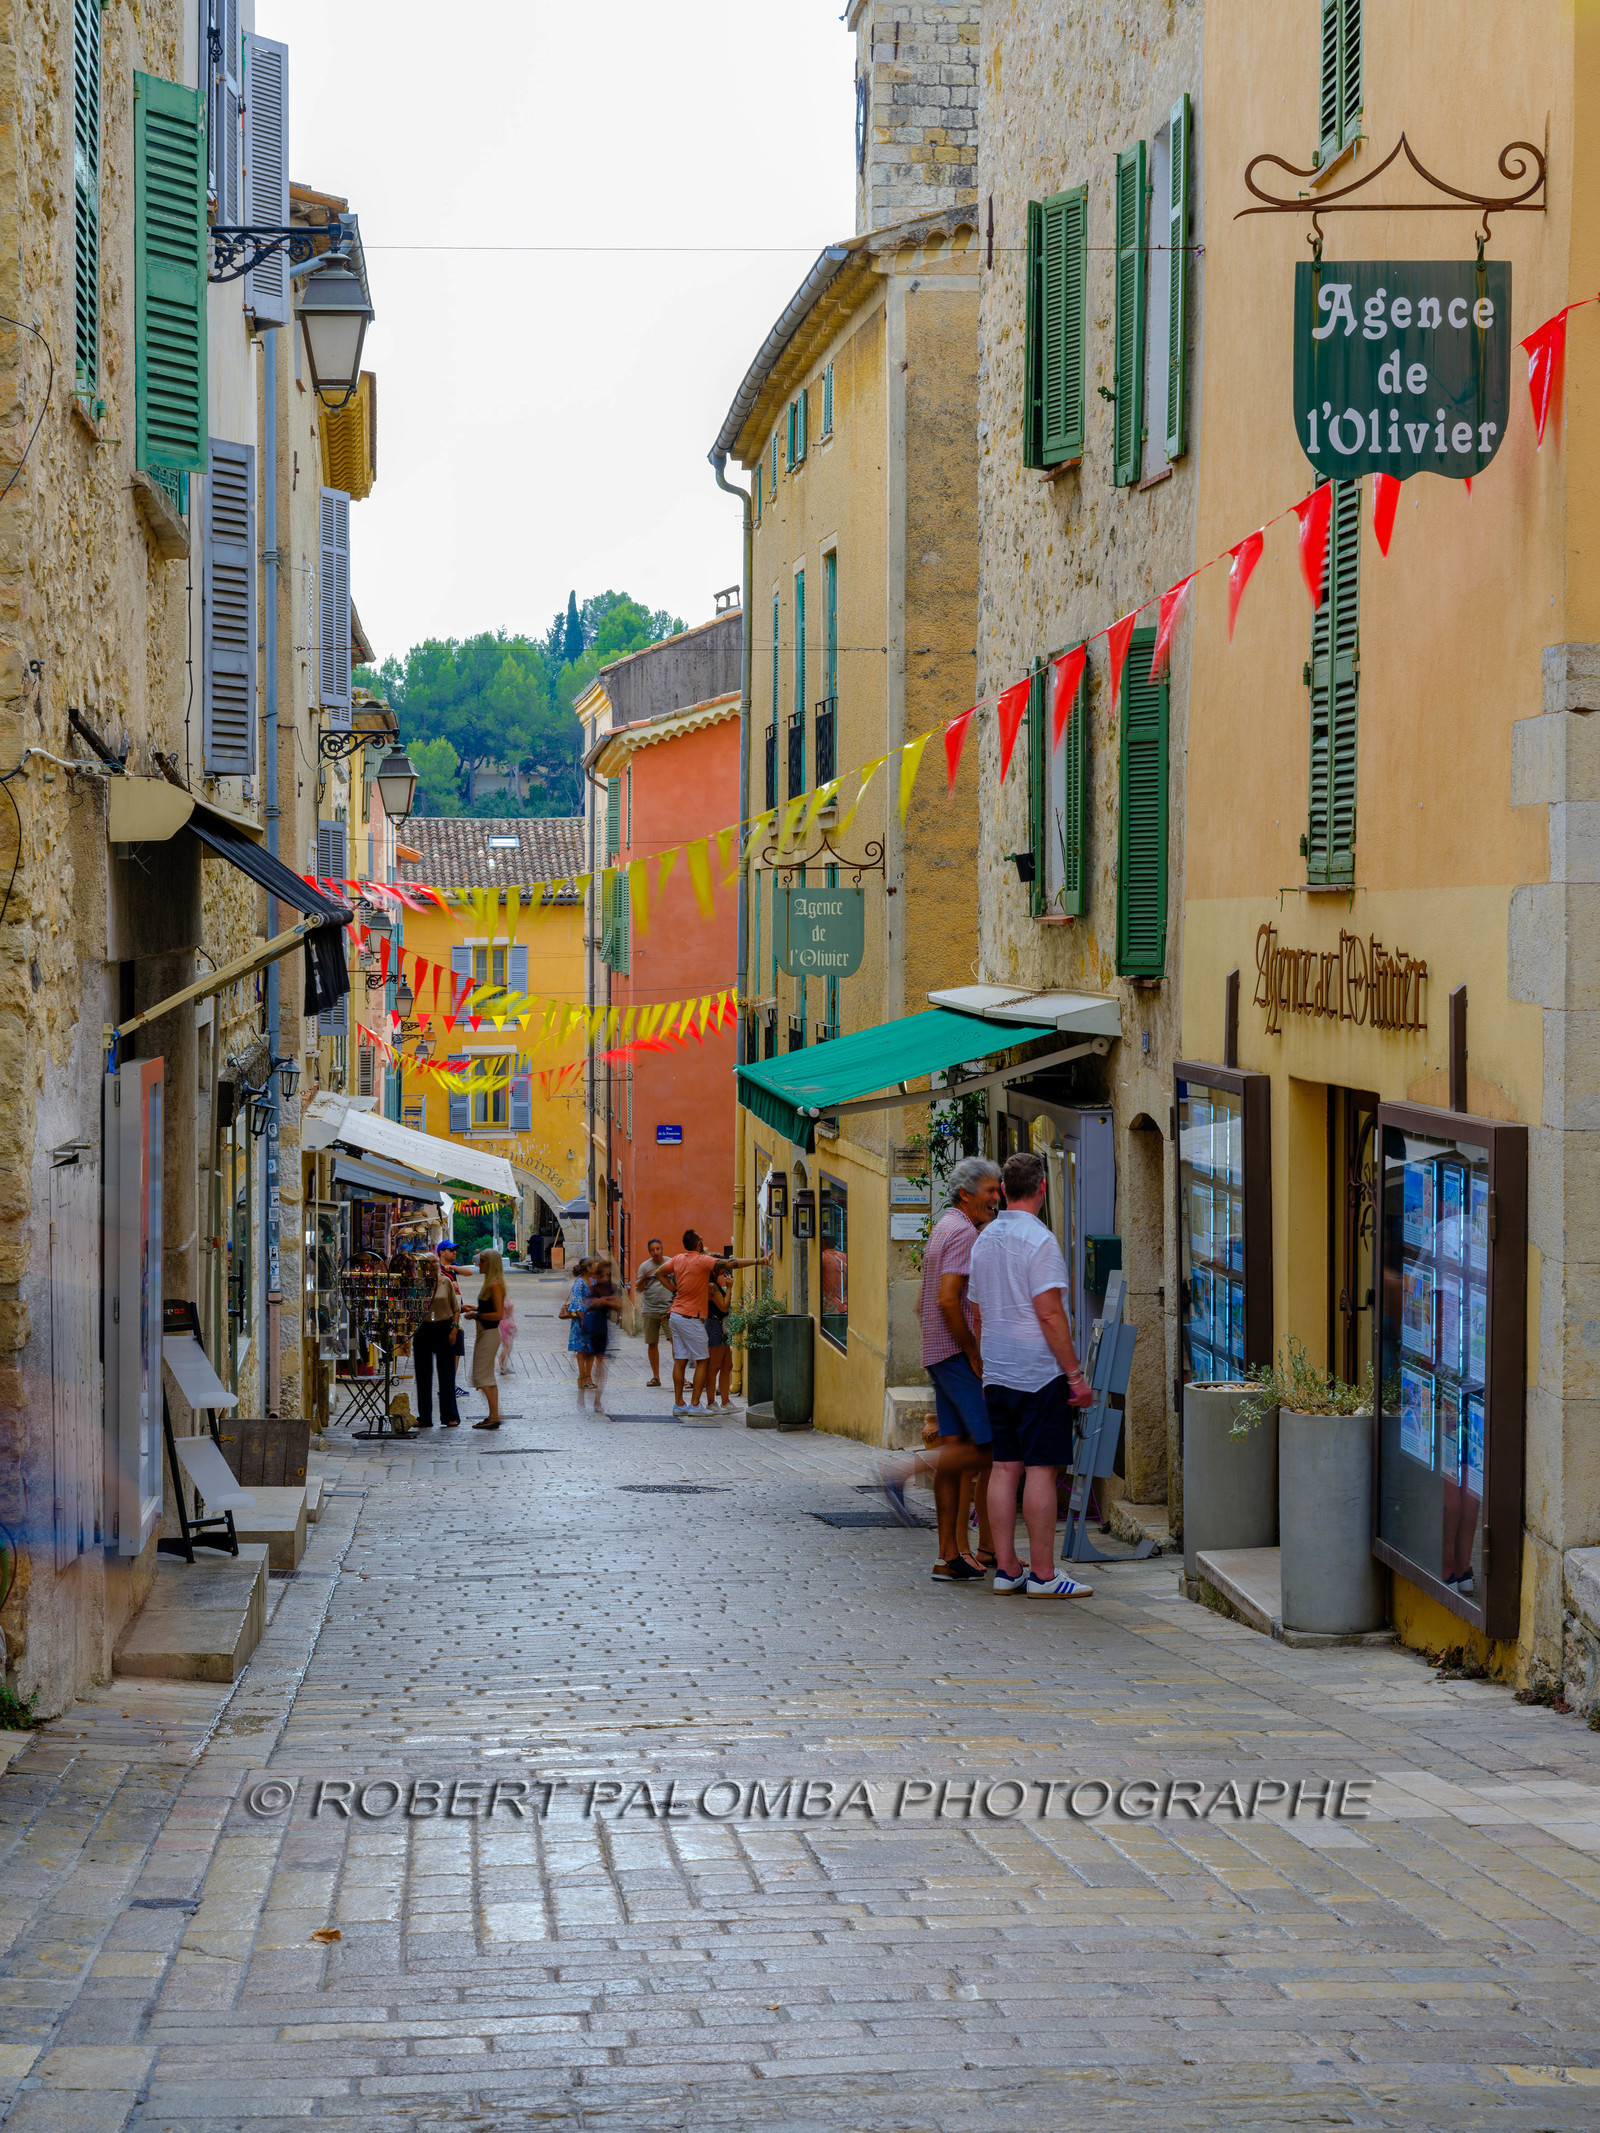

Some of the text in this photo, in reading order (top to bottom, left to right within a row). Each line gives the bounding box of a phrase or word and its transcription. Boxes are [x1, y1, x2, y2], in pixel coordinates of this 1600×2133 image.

[1311, 282, 1495, 340] Agence
[1377, 349, 1428, 395] de
[1305, 401, 1498, 455] l'Olivier
[794, 898, 843, 918] Agence
[812, 924, 826, 942] de
[790, 949, 849, 967] l'Olivier
[1252, 921, 1314, 1035] Agence
[1314, 951, 1338, 1020] de
